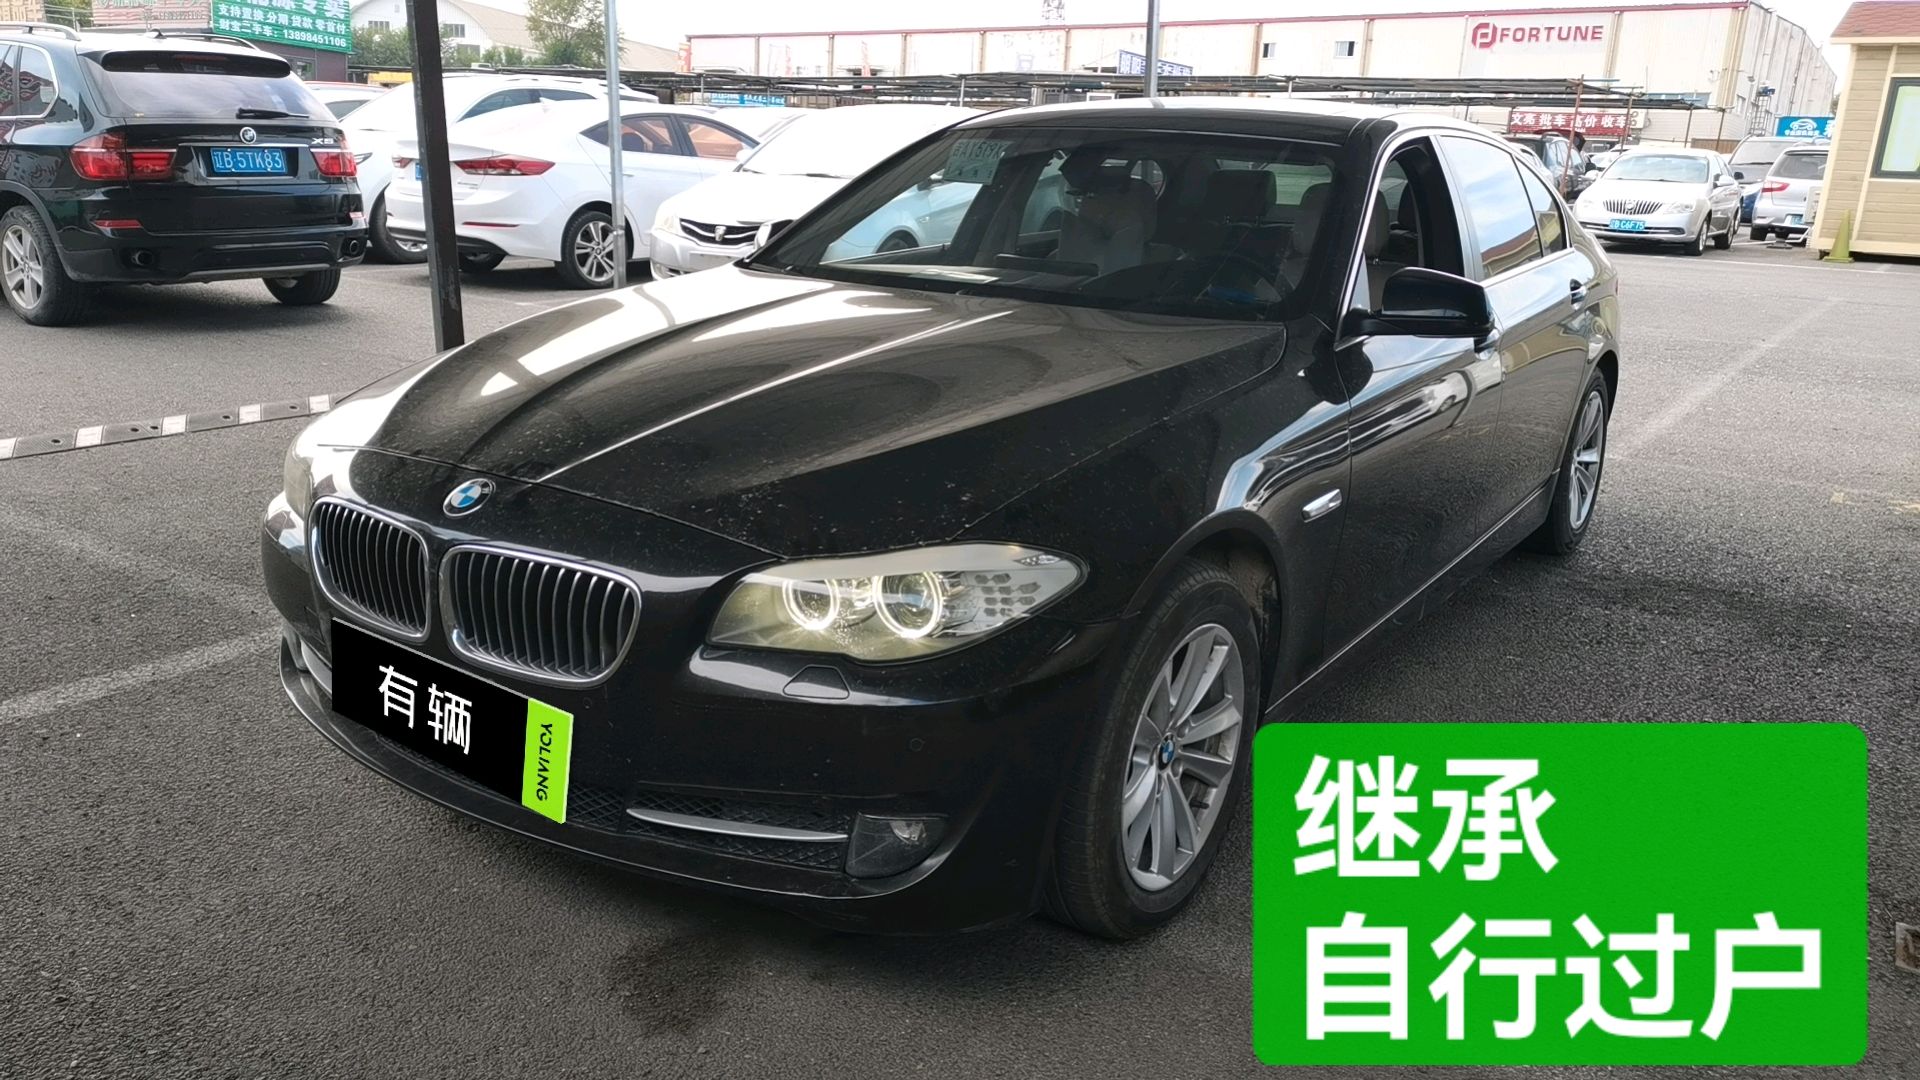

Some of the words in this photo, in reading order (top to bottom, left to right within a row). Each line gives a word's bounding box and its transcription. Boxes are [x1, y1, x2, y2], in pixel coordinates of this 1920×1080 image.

[218, 3, 264, 22] 支持置换
[267, 11, 289, 26] 分期
[291, 15, 313, 30] 贷款
[315, 19, 347, 35] 零首付
[283, 29, 347, 48] 13898451106
[1499, 25, 1604, 43] FORTUNE
